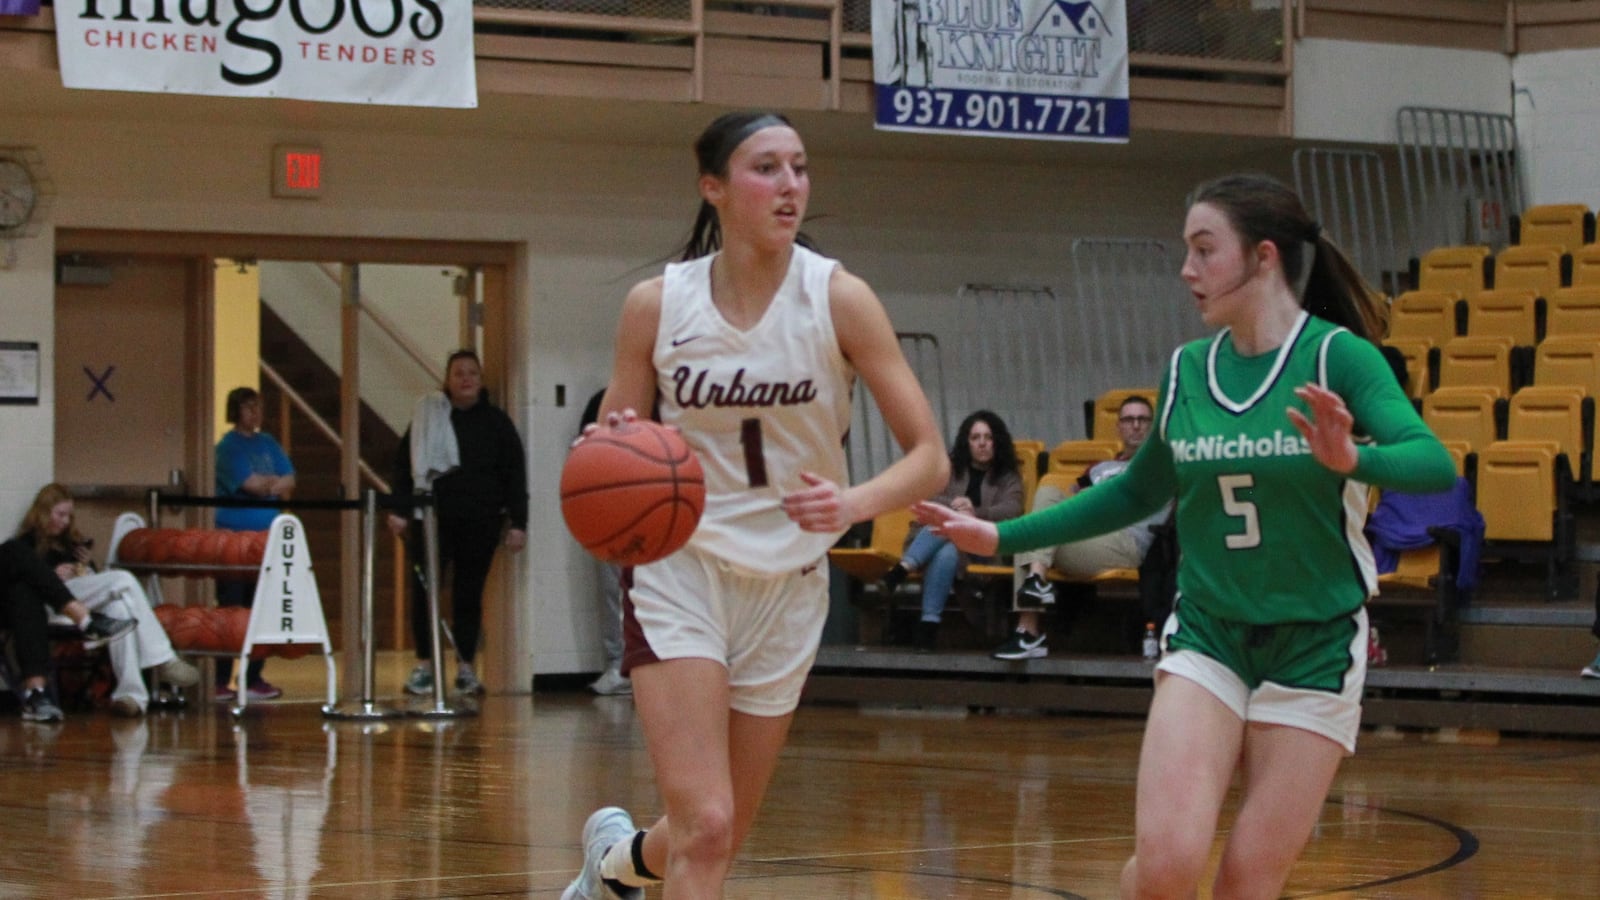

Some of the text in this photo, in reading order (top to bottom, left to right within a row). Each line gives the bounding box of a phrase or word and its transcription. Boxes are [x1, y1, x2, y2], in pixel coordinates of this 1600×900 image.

[918, 0, 1024, 32] BLUE
[84, 29, 436, 67] CHICKEN TENDERS
[937, 28, 1101, 78] KNIGHT
[893, 88, 1106, 134] 937.901.7721
[287, 153, 321, 188] EXIT
[672, 366, 818, 409] Urbana
[741, 418, 769, 488] 1
[1217, 473, 1262, 550] 5
[281, 525, 295, 632] BUTLER
